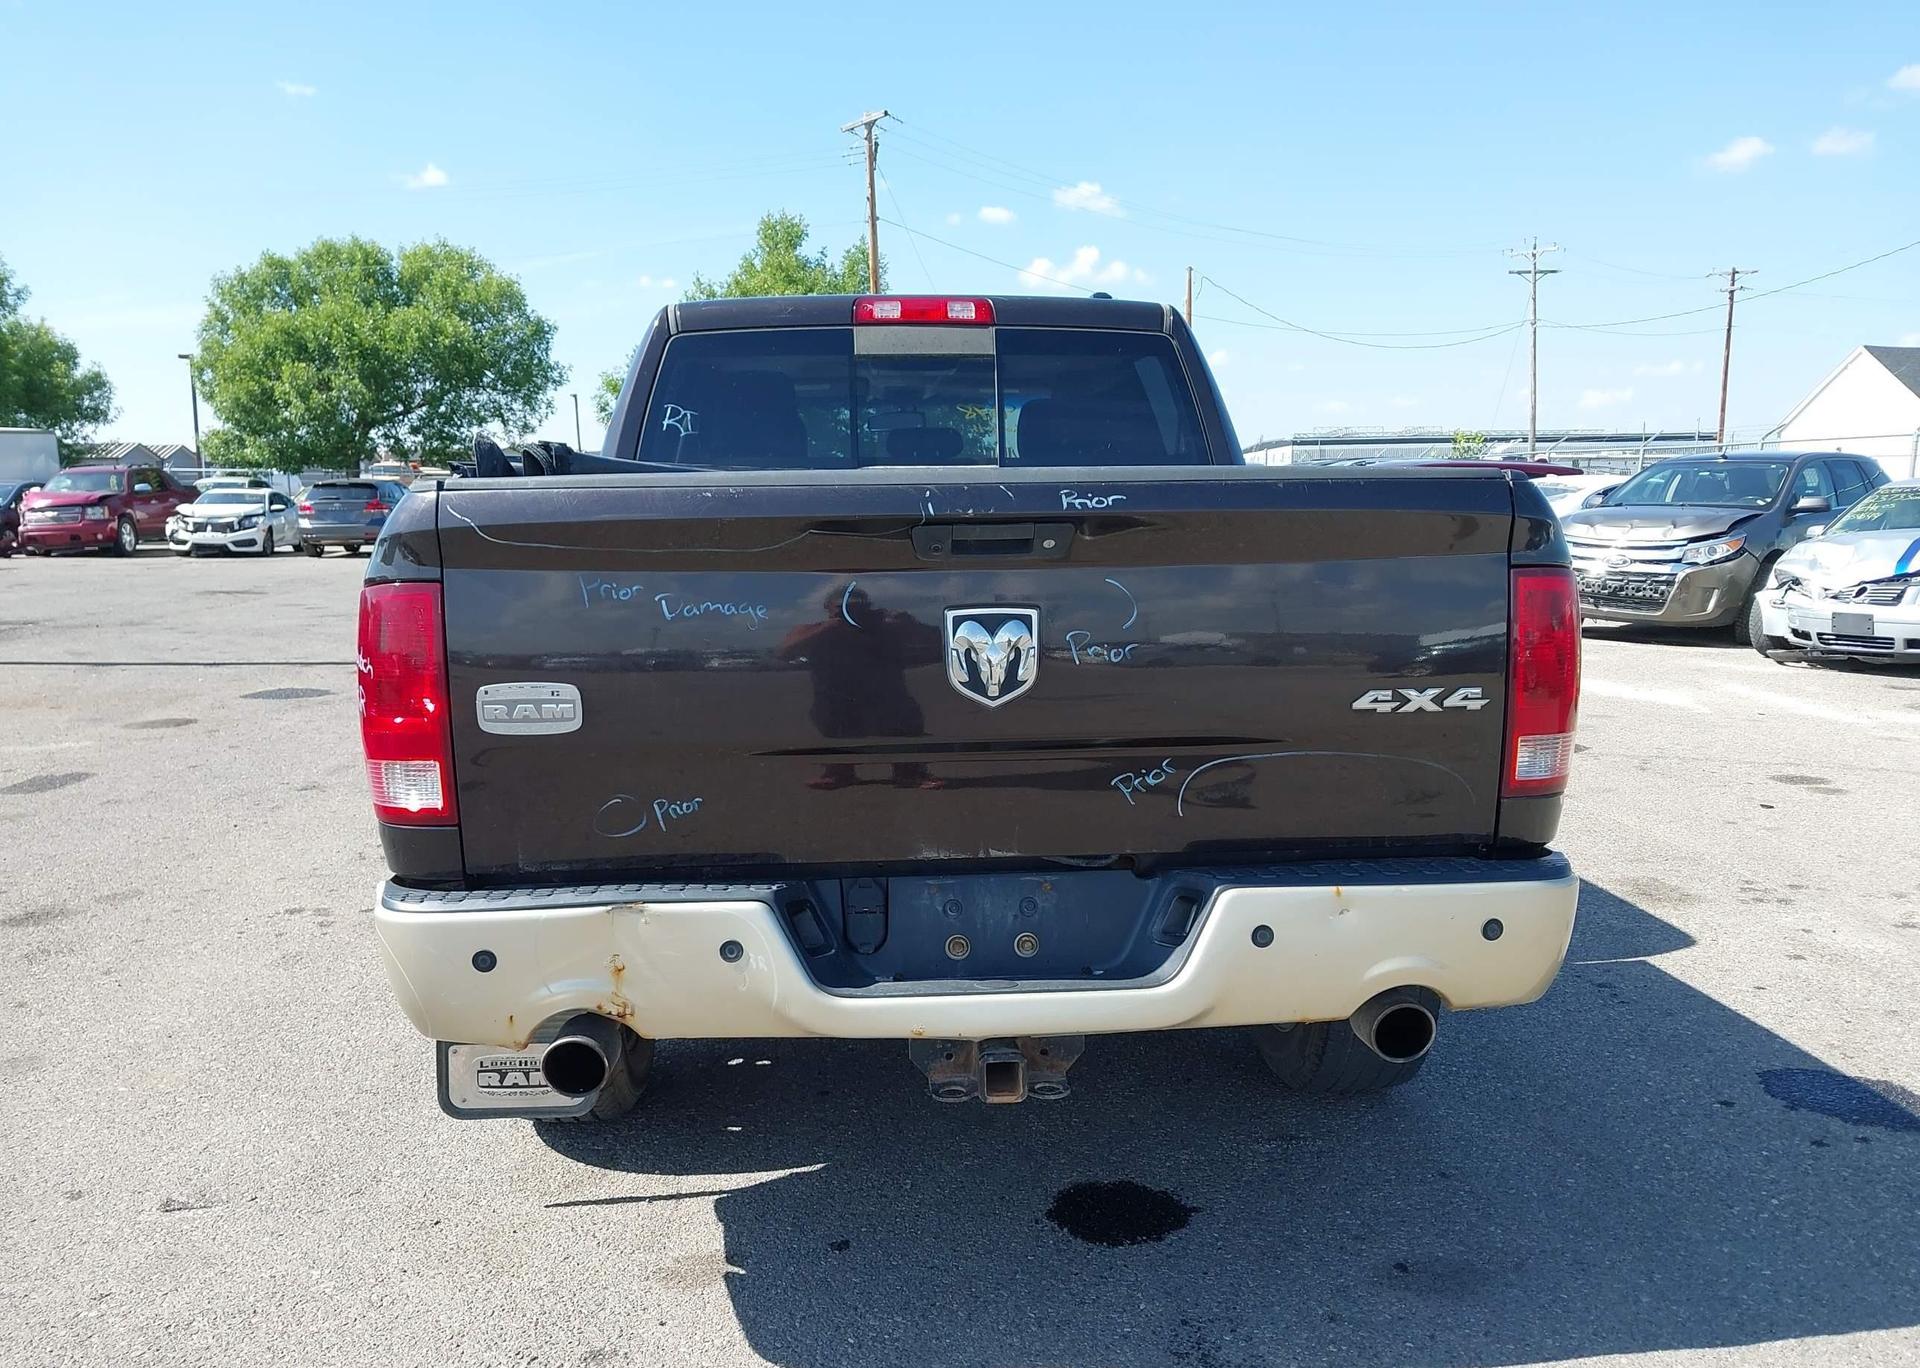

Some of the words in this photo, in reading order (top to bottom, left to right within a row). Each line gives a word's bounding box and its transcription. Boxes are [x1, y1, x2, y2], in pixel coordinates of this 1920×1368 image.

[1059, 489, 1127, 511] Prior
[578, 575, 644, 609] Prior
[654, 592, 769, 631] Damage
[1066, 630, 1139, 666] Prior
[483, 704, 575, 719] RAM
[1110, 757, 1177, 806] Prior
[653, 797, 703, 832] Prior
